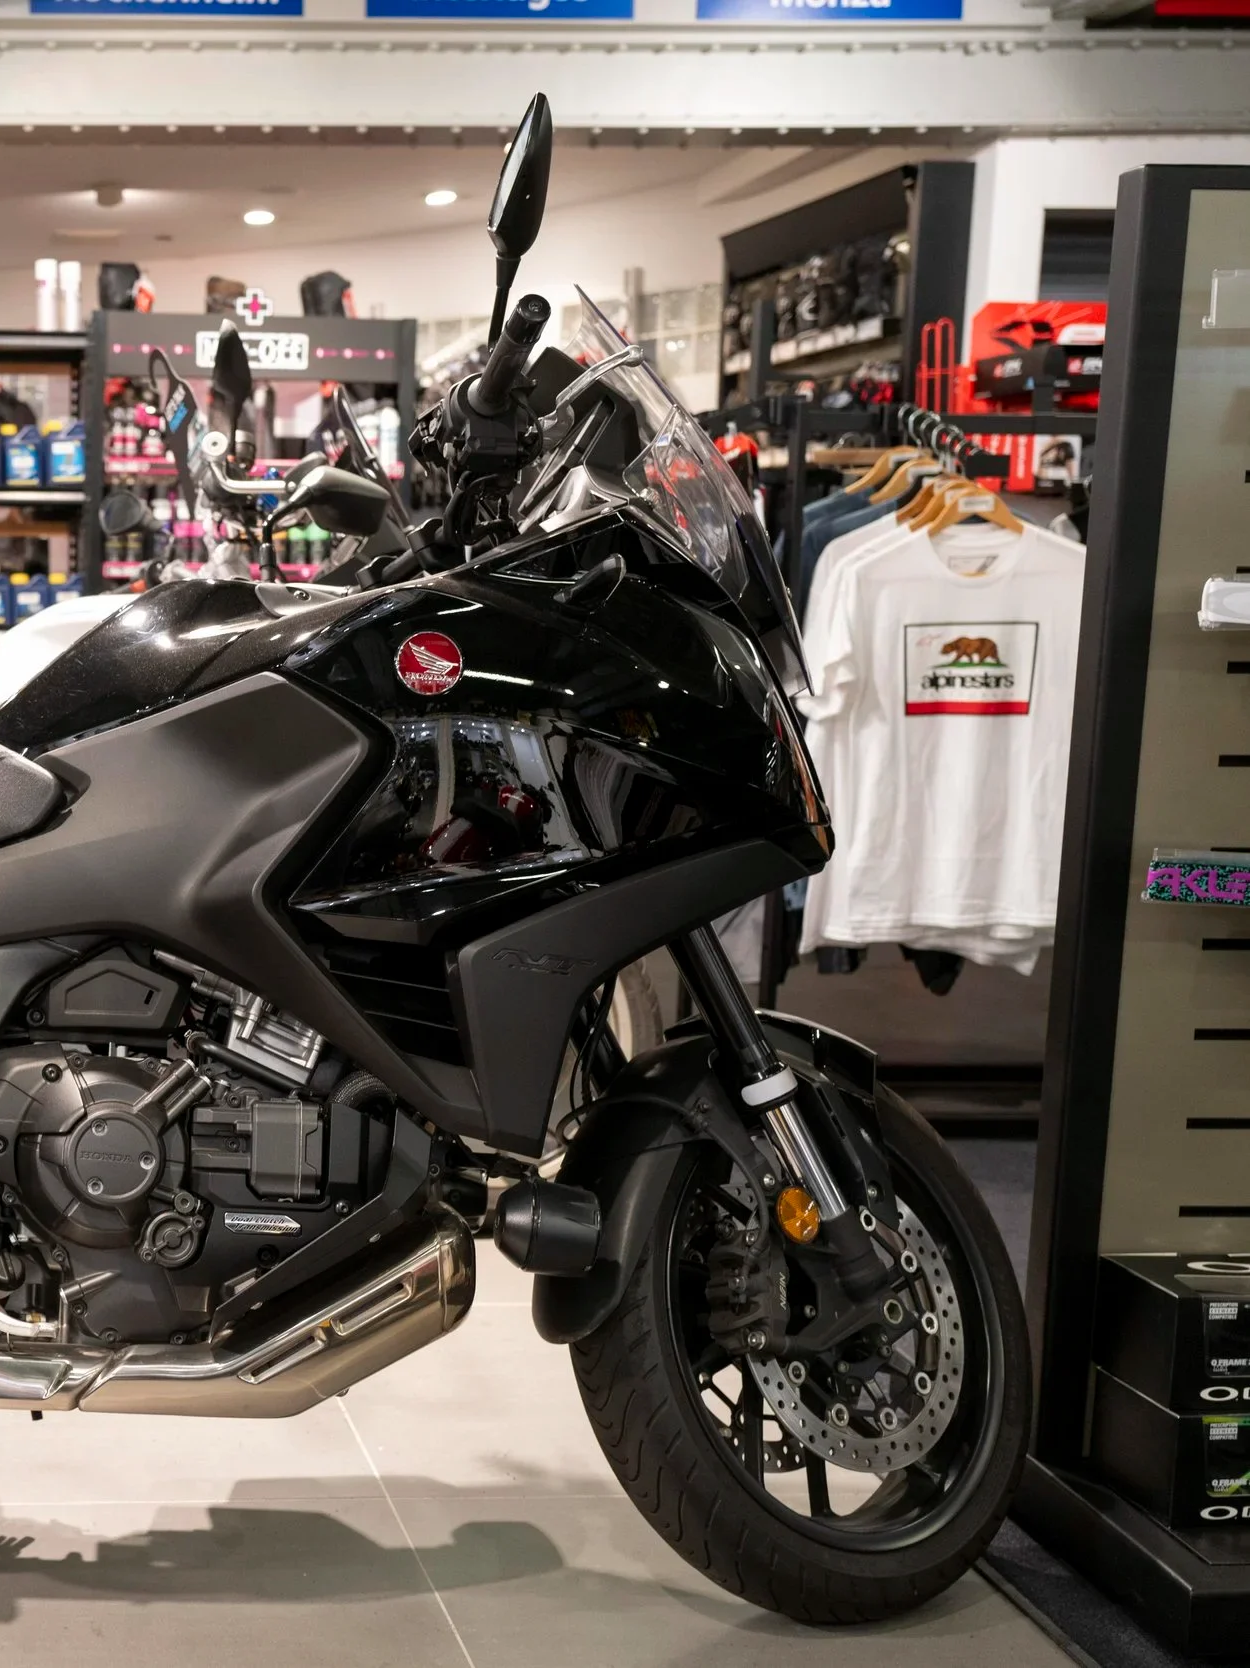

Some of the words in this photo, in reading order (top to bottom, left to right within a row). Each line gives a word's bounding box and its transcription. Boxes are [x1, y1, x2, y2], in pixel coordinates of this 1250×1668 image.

[921, 671, 1014, 692] alpinestars
[79, 1151, 134, 1163] HONDA
[235, 1223, 299, 1232] Transmission
